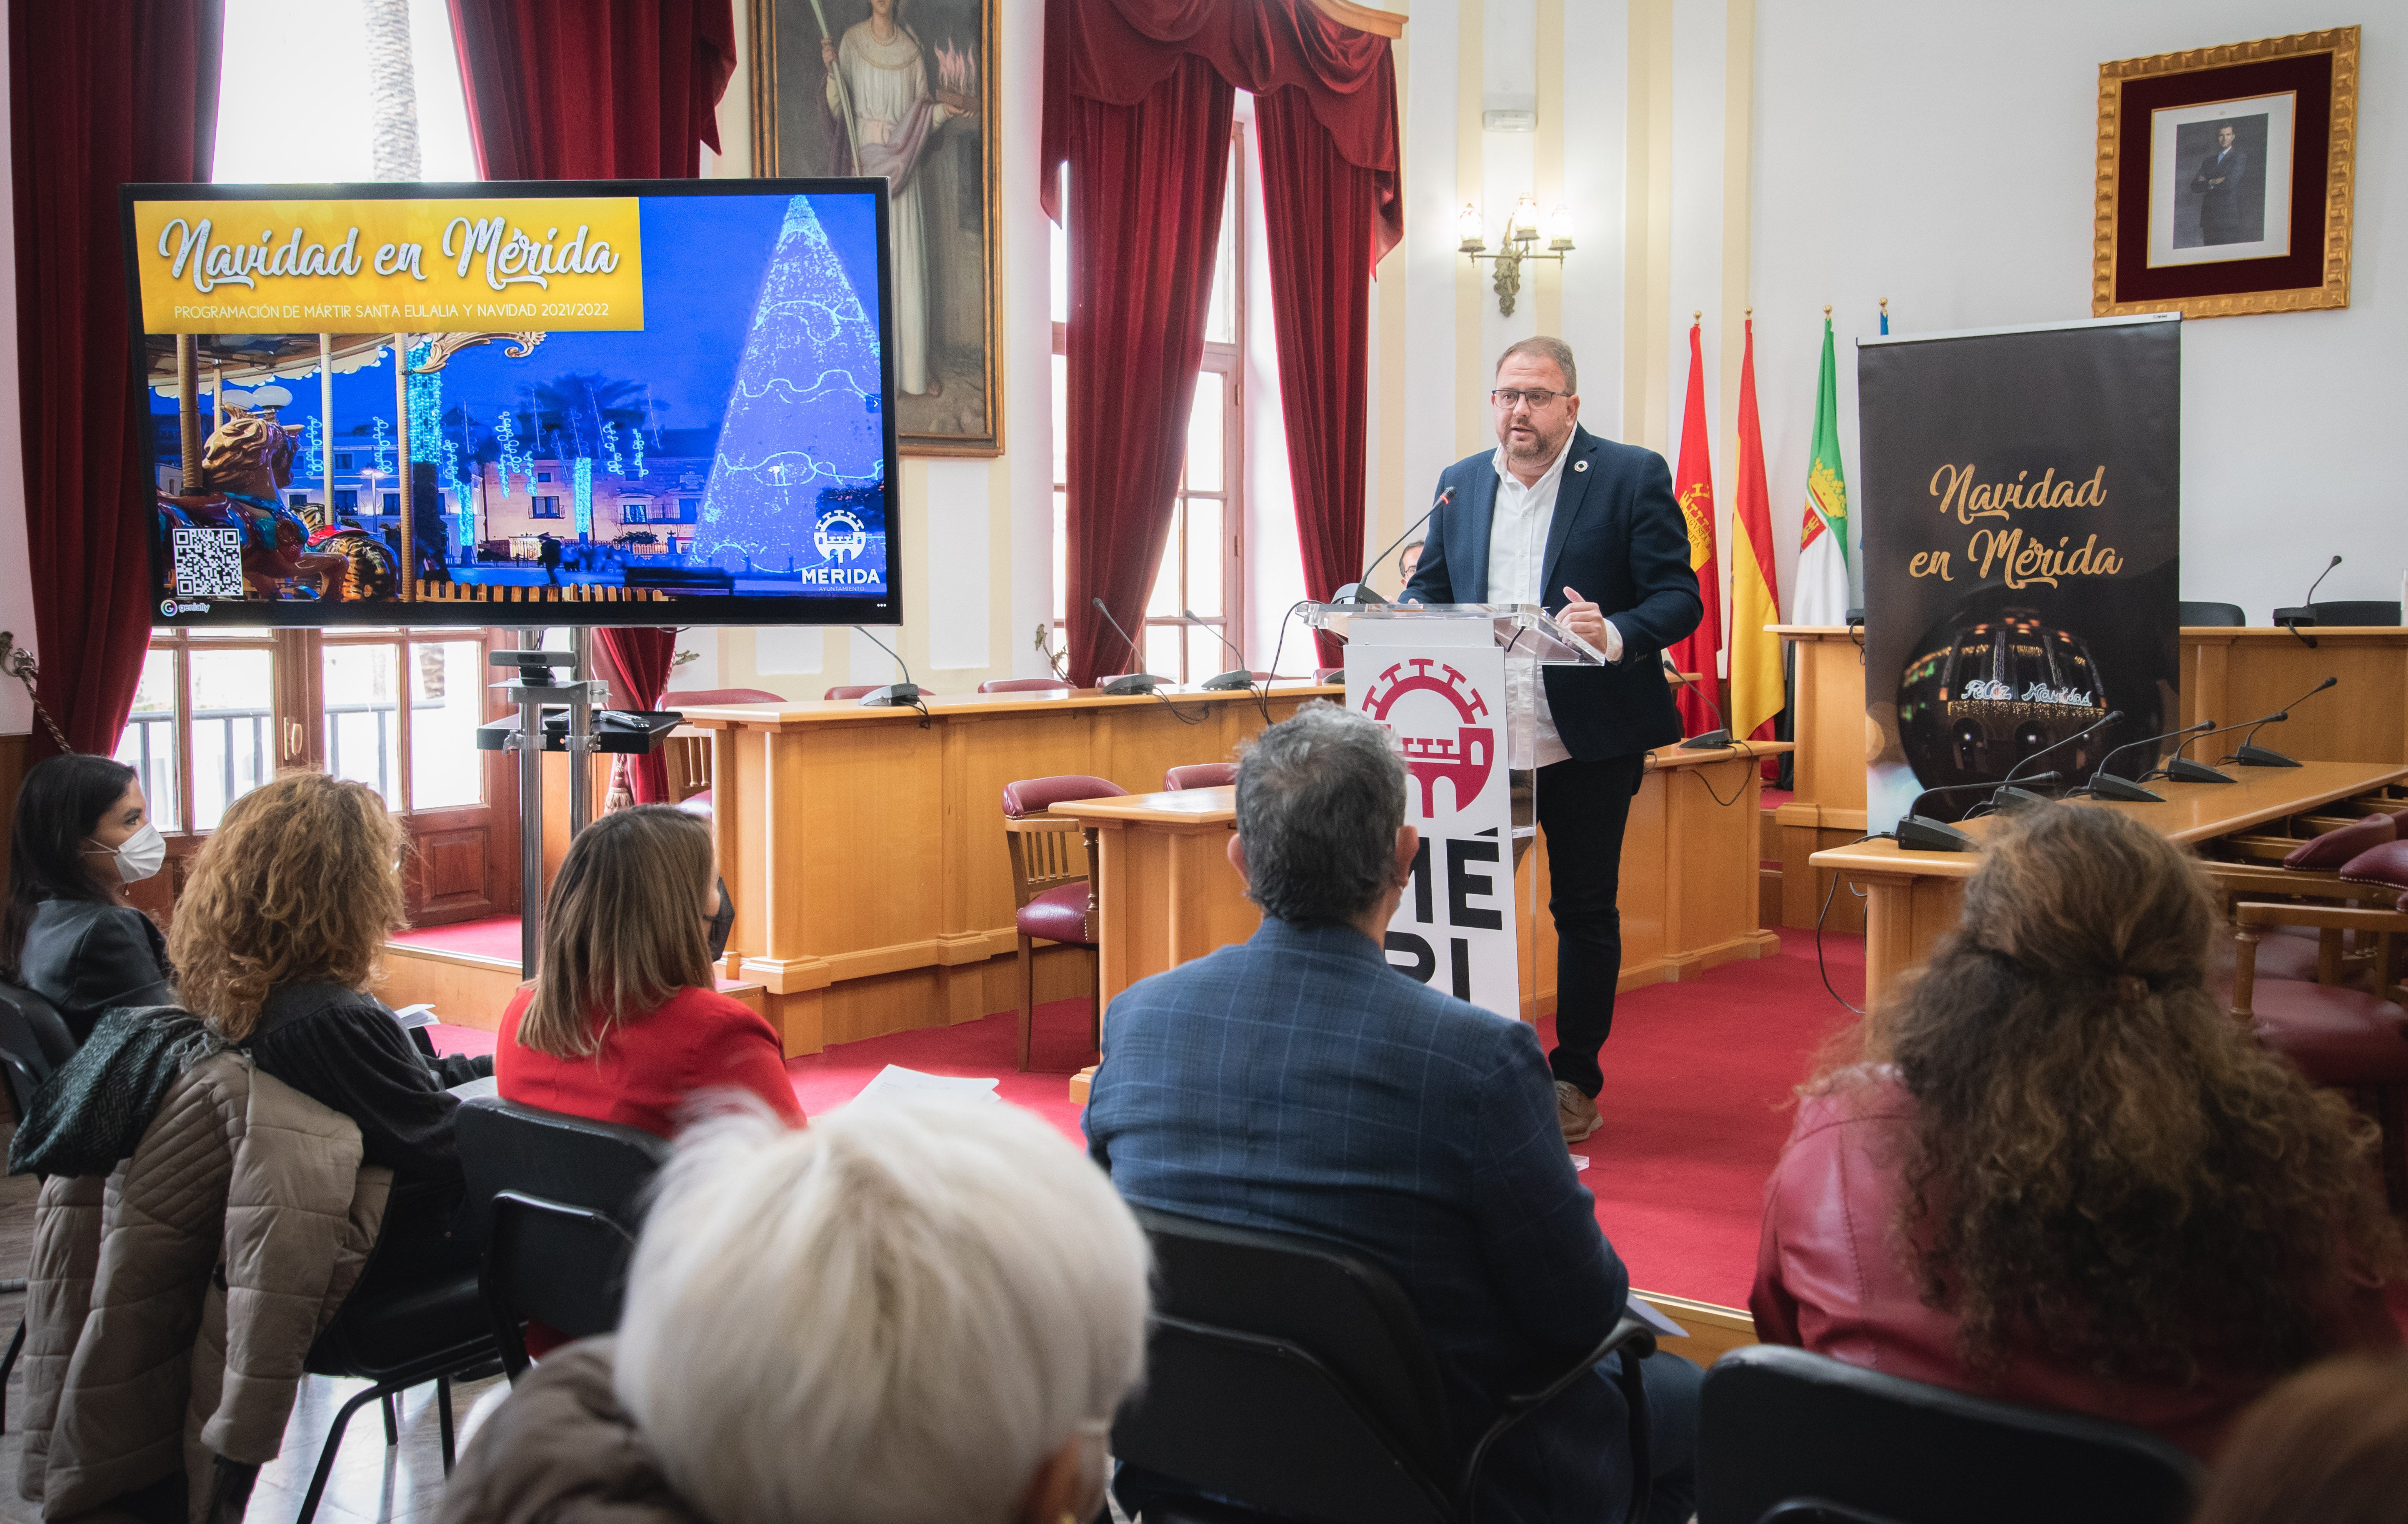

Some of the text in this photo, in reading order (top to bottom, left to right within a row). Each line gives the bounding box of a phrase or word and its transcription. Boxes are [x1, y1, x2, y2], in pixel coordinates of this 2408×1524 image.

[158, 216, 619, 293] Navidad en Mérida
[175, 303, 609, 318] PROGRAMACIÓN DE MÁRTIR SANTA EULALIA Y NAVIDAD 2021/2022
[1930, 463, 2107, 525] Navidad
[1909, 528, 2123, 589] en Mérida
[802, 567, 880, 584] MÉRIDA
[178, 602, 210, 613] genially
[2021, 682, 2092, 707] Navidad
